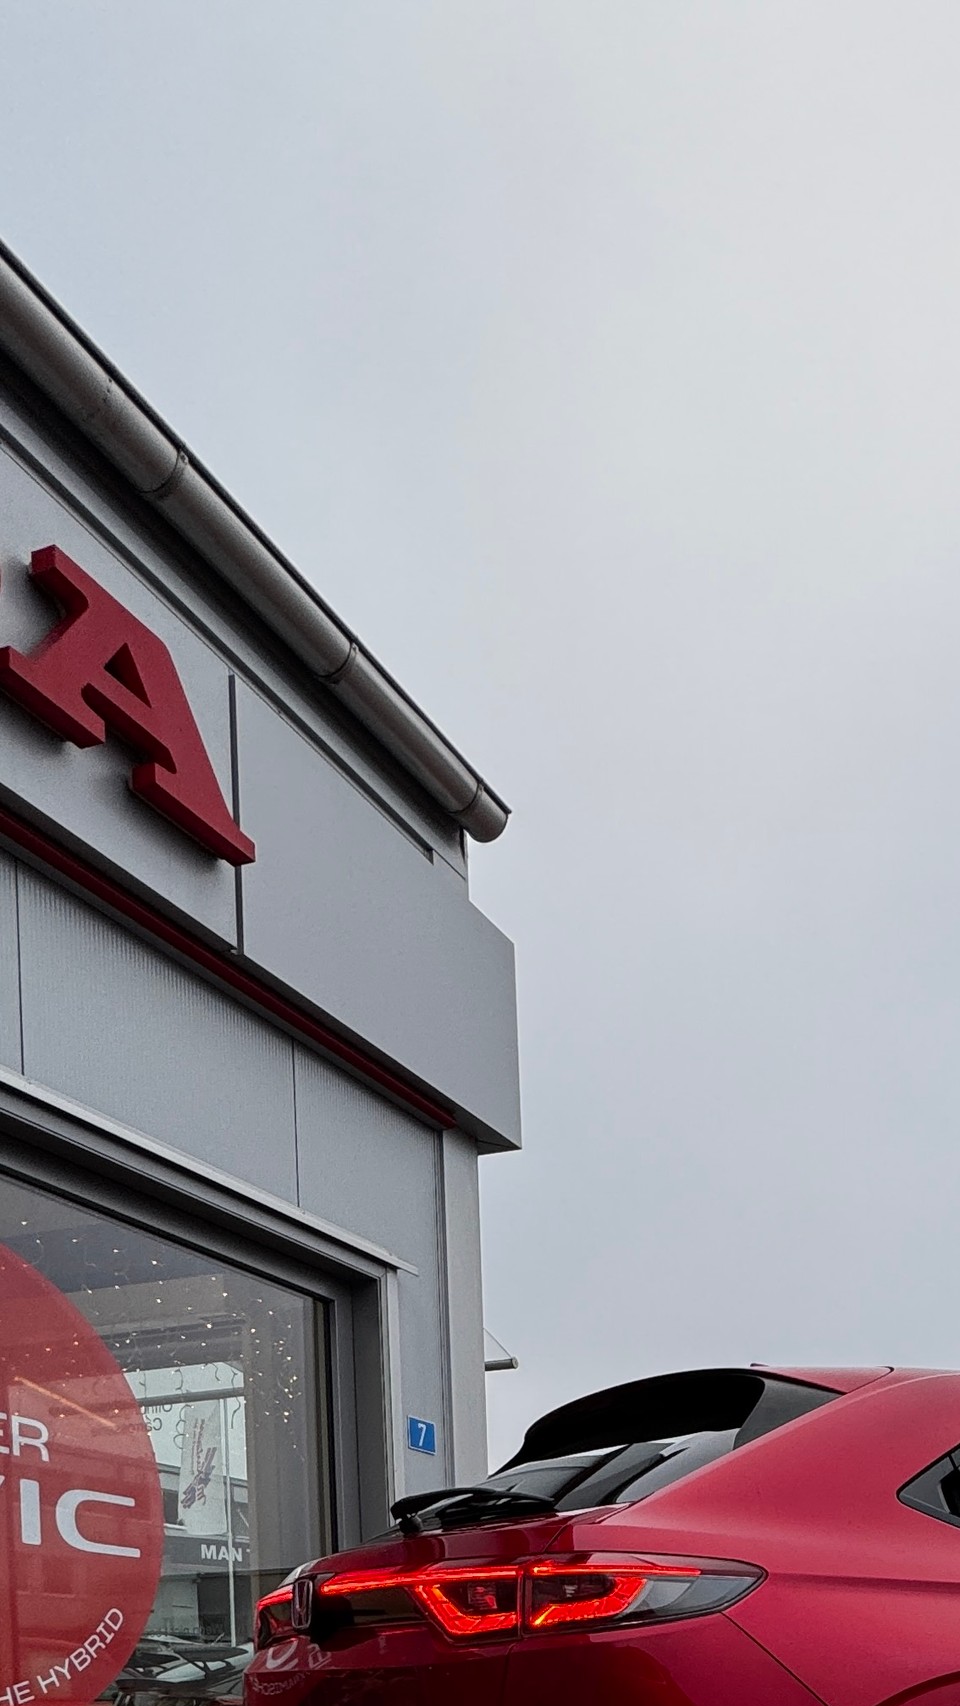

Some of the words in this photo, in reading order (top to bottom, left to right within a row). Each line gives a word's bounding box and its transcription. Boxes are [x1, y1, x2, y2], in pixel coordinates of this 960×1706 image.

[417, 1422, 427, 1447] 7
[0, 1475, 141, 1558] IC
[201, 1543, 243, 1562] MAN
[36, 1607, 124, 1694] HYBRID
